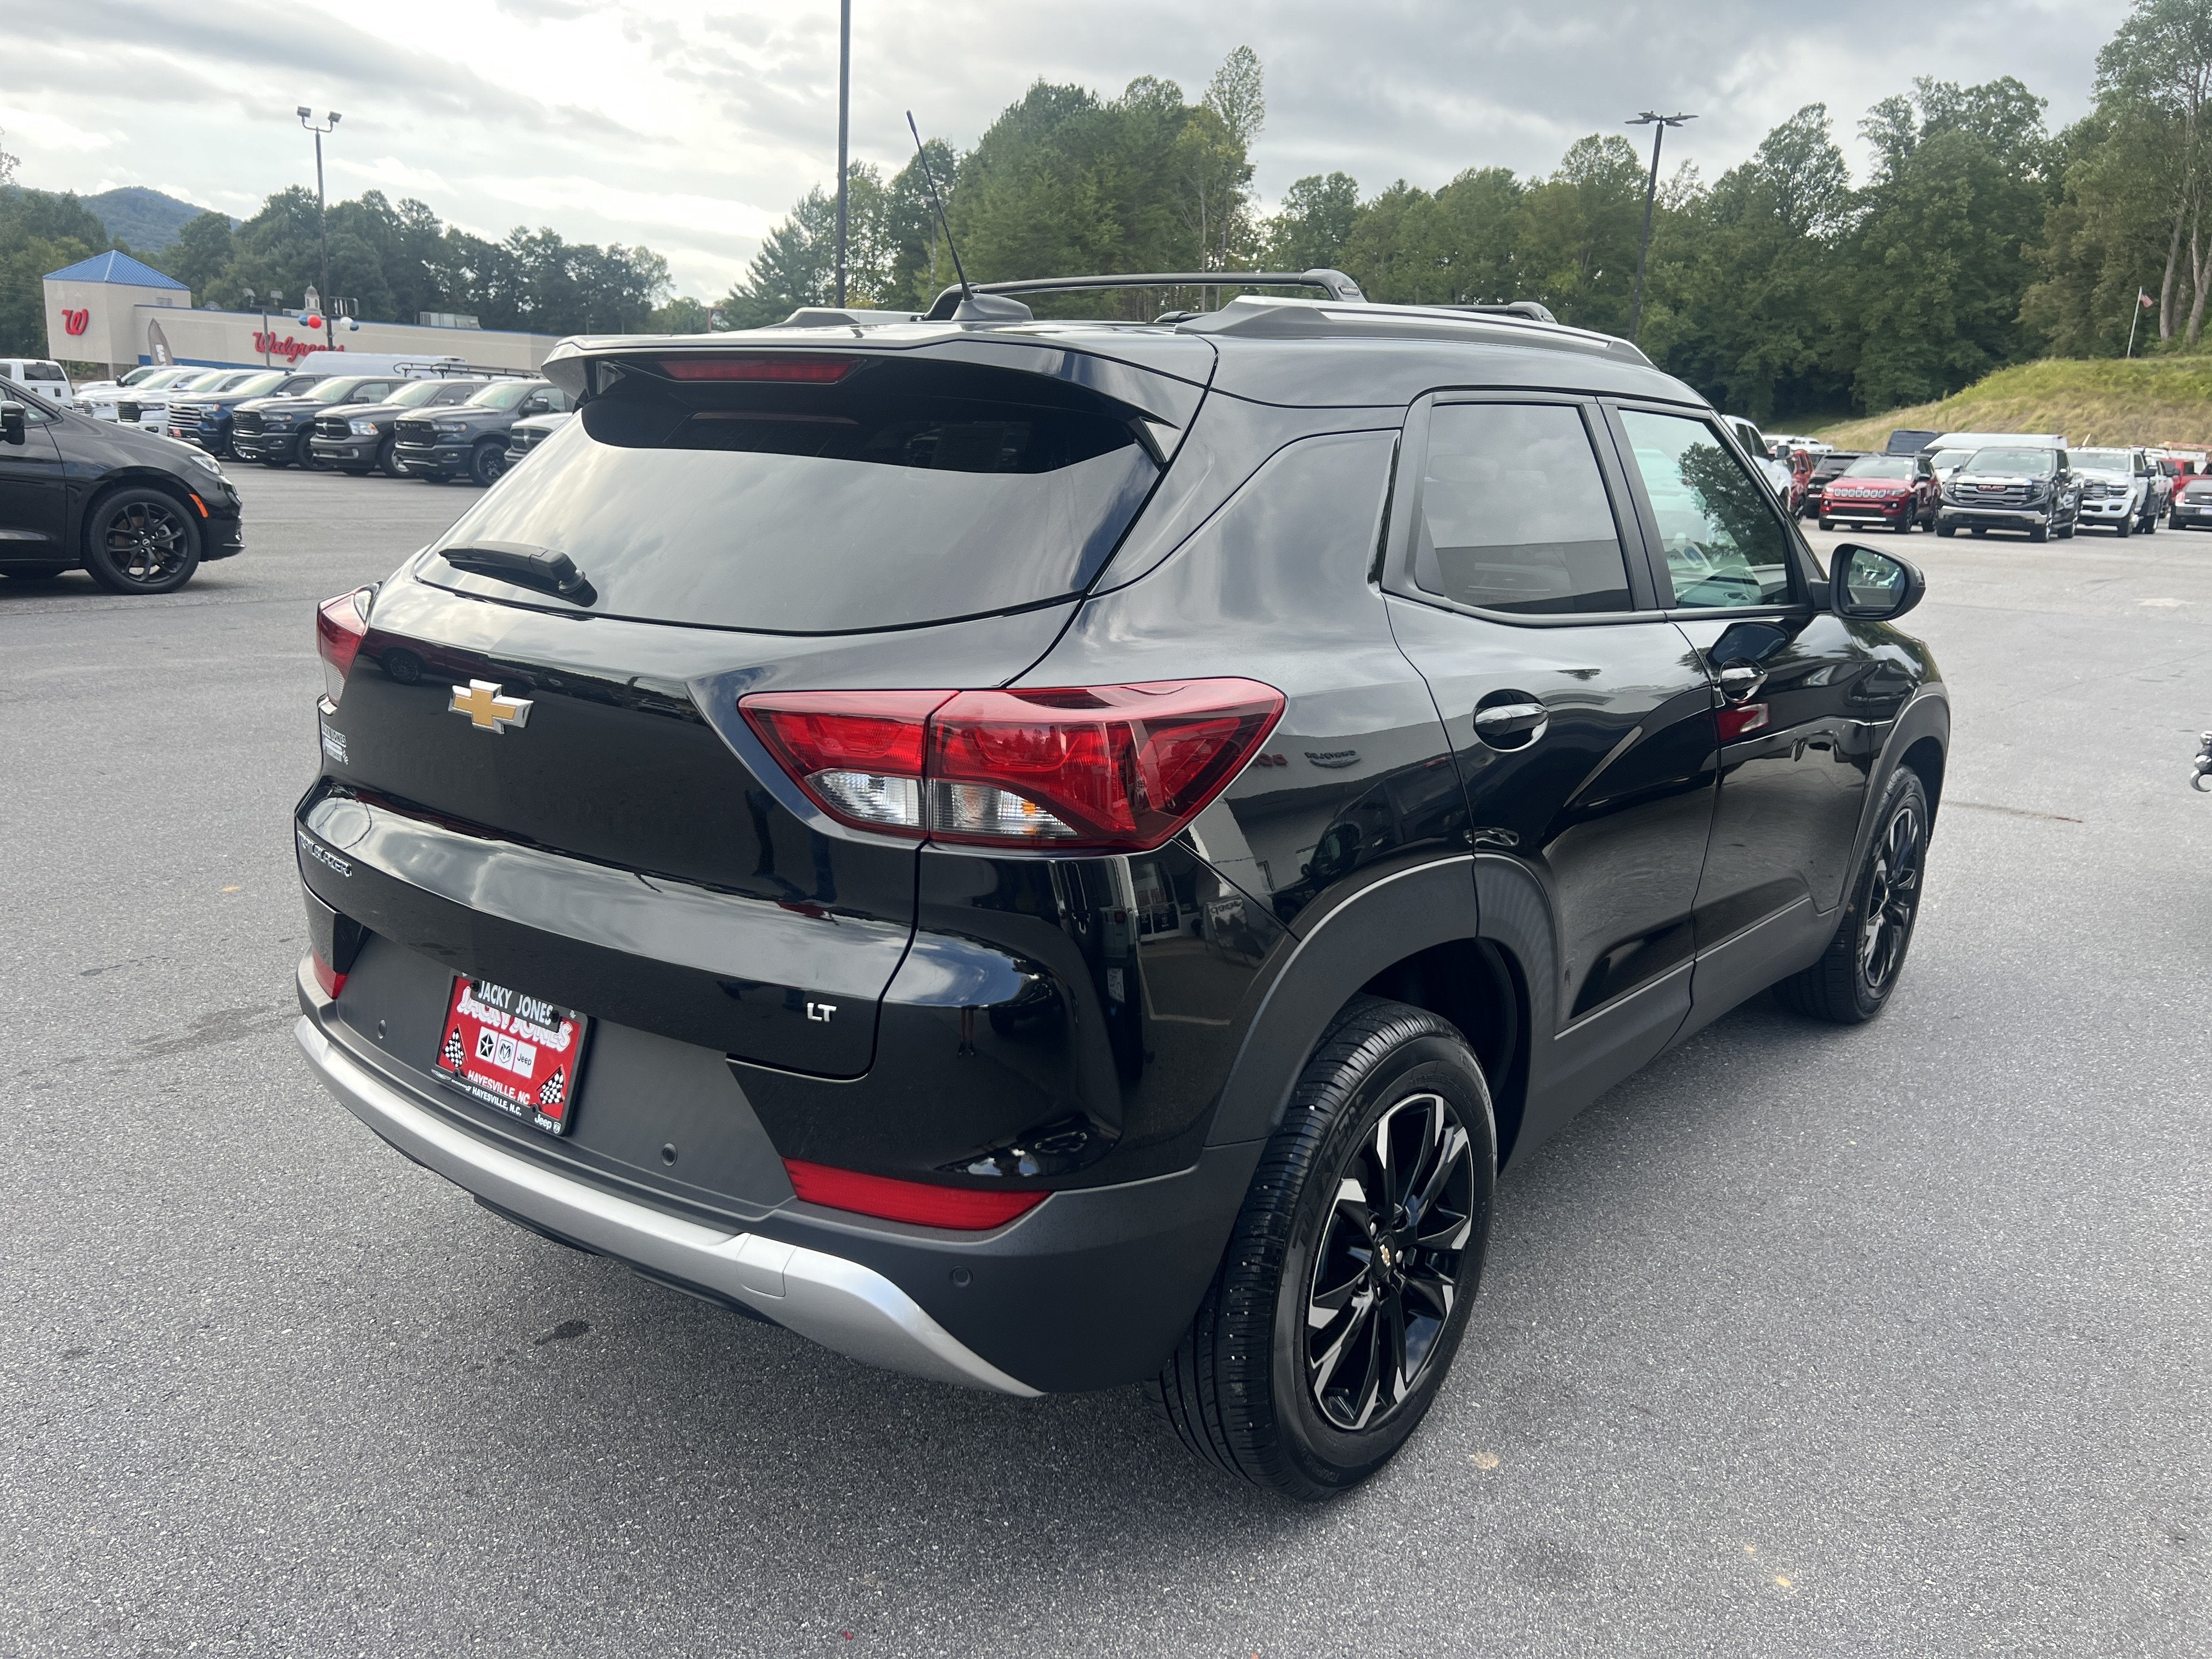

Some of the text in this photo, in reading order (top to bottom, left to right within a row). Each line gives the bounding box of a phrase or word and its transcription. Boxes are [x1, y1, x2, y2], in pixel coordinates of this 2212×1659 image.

[61, 307, 89, 335] W
[478, 980, 554, 1025] JACKY JONES
[806, 1002, 837, 1023] LT
[517, 1053, 532, 1066] Jeep
[472, 1086, 522, 1116] HAYESVILLE, N.C.
[517, 1090, 531, 1105] NC
[534, 1114, 552, 1130] Jeep
